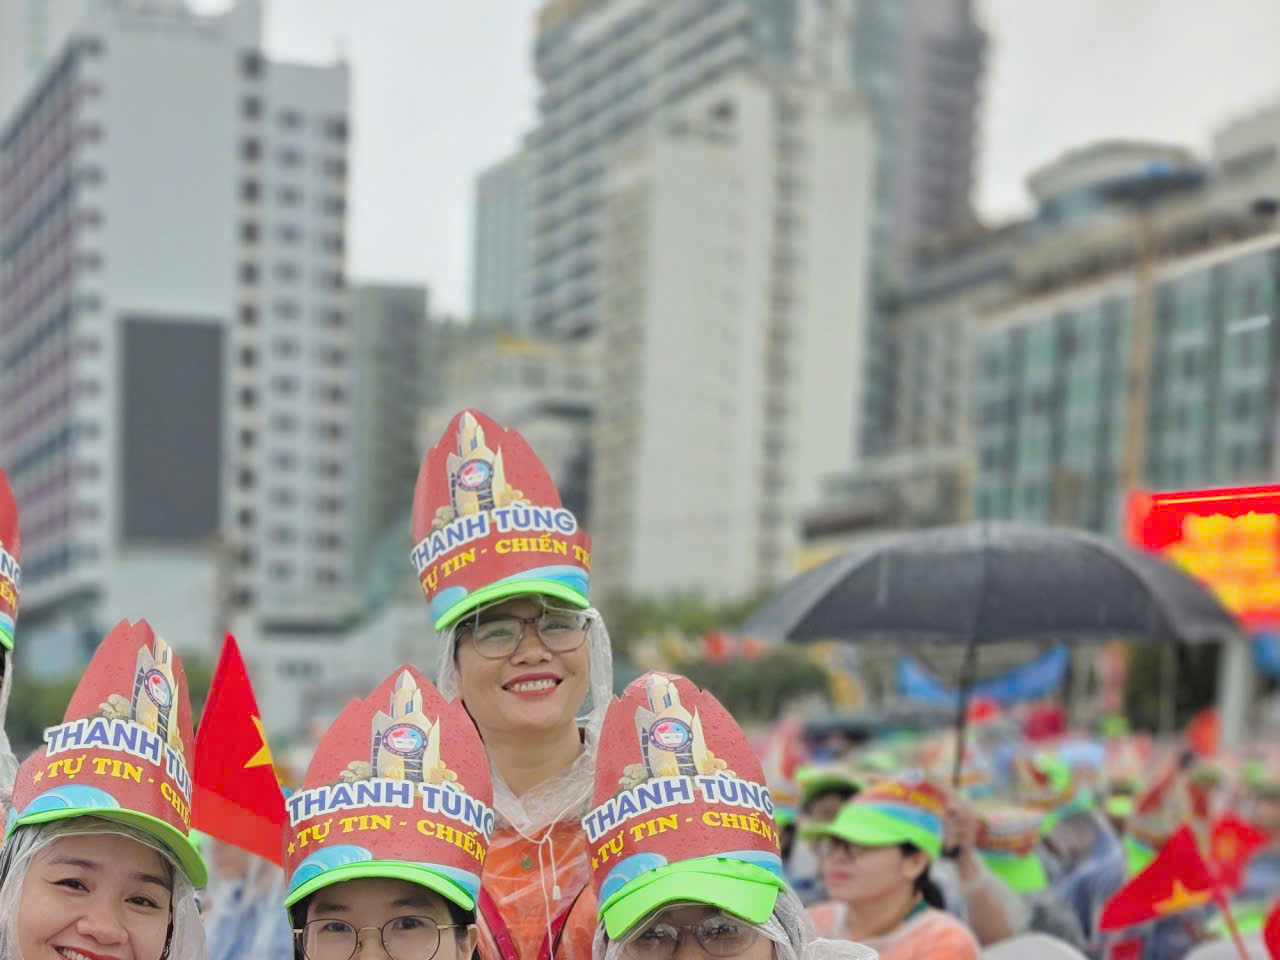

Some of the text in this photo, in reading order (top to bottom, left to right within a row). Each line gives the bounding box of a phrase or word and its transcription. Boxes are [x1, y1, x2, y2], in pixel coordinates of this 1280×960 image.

[495, 503, 575, 532] TÙNG
[422, 566, 439, 595] TỰ
[441, 547, 476, 578] TIN
[495, 533, 568, 556] CHIẾN
[47, 720, 160, 761] THANH
[48, 754, 87, 778] TỰ
[93, 757, 144, 783] TIN
[288, 782, 495, 840] THANH TÙNG
[584, 774, 774, 839] THANH TÙNG
[297, 819, 333, 844] TỰ
[339, 815, 393, 834] TIN
[416, 819, 488, 865] CHIẾN
[597, 827, 625, 863] TỰ
[630, 813, 679, 842] TIN
[702, 811, 772, 841] CHIẾN
